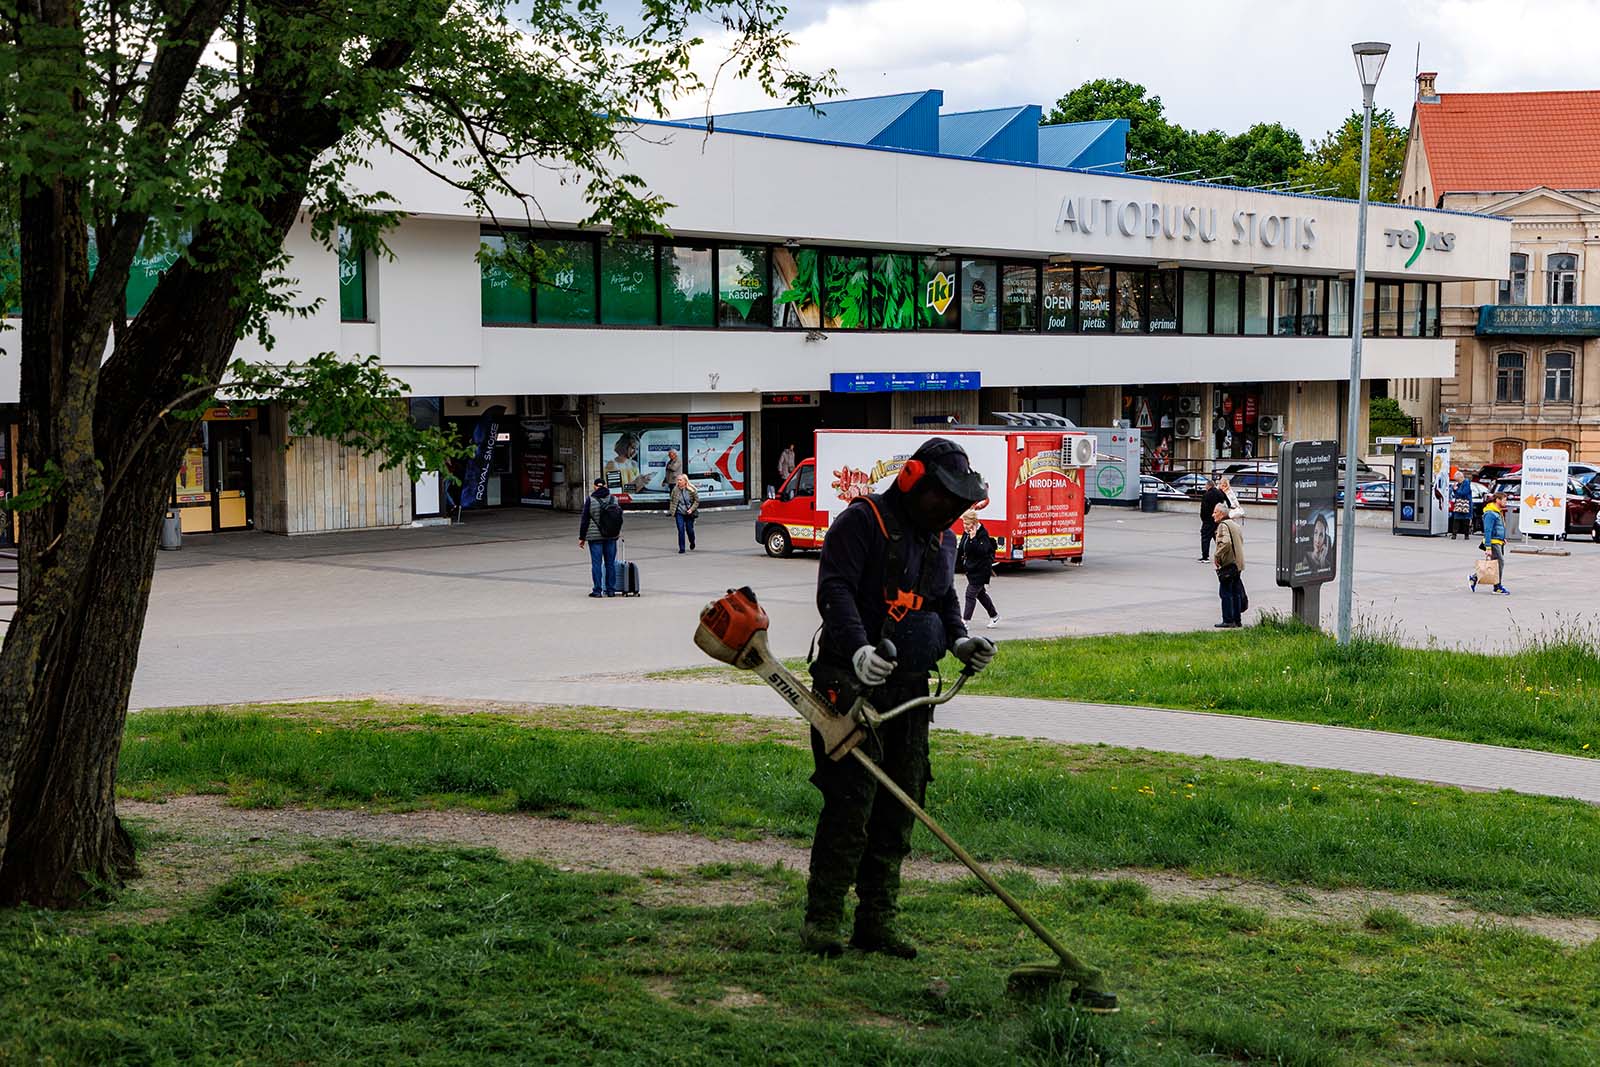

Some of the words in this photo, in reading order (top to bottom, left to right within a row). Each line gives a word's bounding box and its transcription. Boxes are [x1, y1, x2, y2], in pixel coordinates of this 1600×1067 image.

[1232, 209, 1317, 250] STOTIS
[927, 274, 955, 307] iki
[1044, 296, 1072, 310] OPEN
[1080, 301, 1110, 311] DIRBAME
[1048, 315, 1066, 330] food
[1083, 317, 1106, 330] pietūs
[1121, 318, 1139, 329] kava
[1150, 318, 1177, 332] gėrimai
[476, 463, 490, 501] ROYAL
[484, 423, 499, 461] SMOKE
[1029, 478, 1067, 489] NIRODEMA
[768, 672, 801, 706] STIHL
